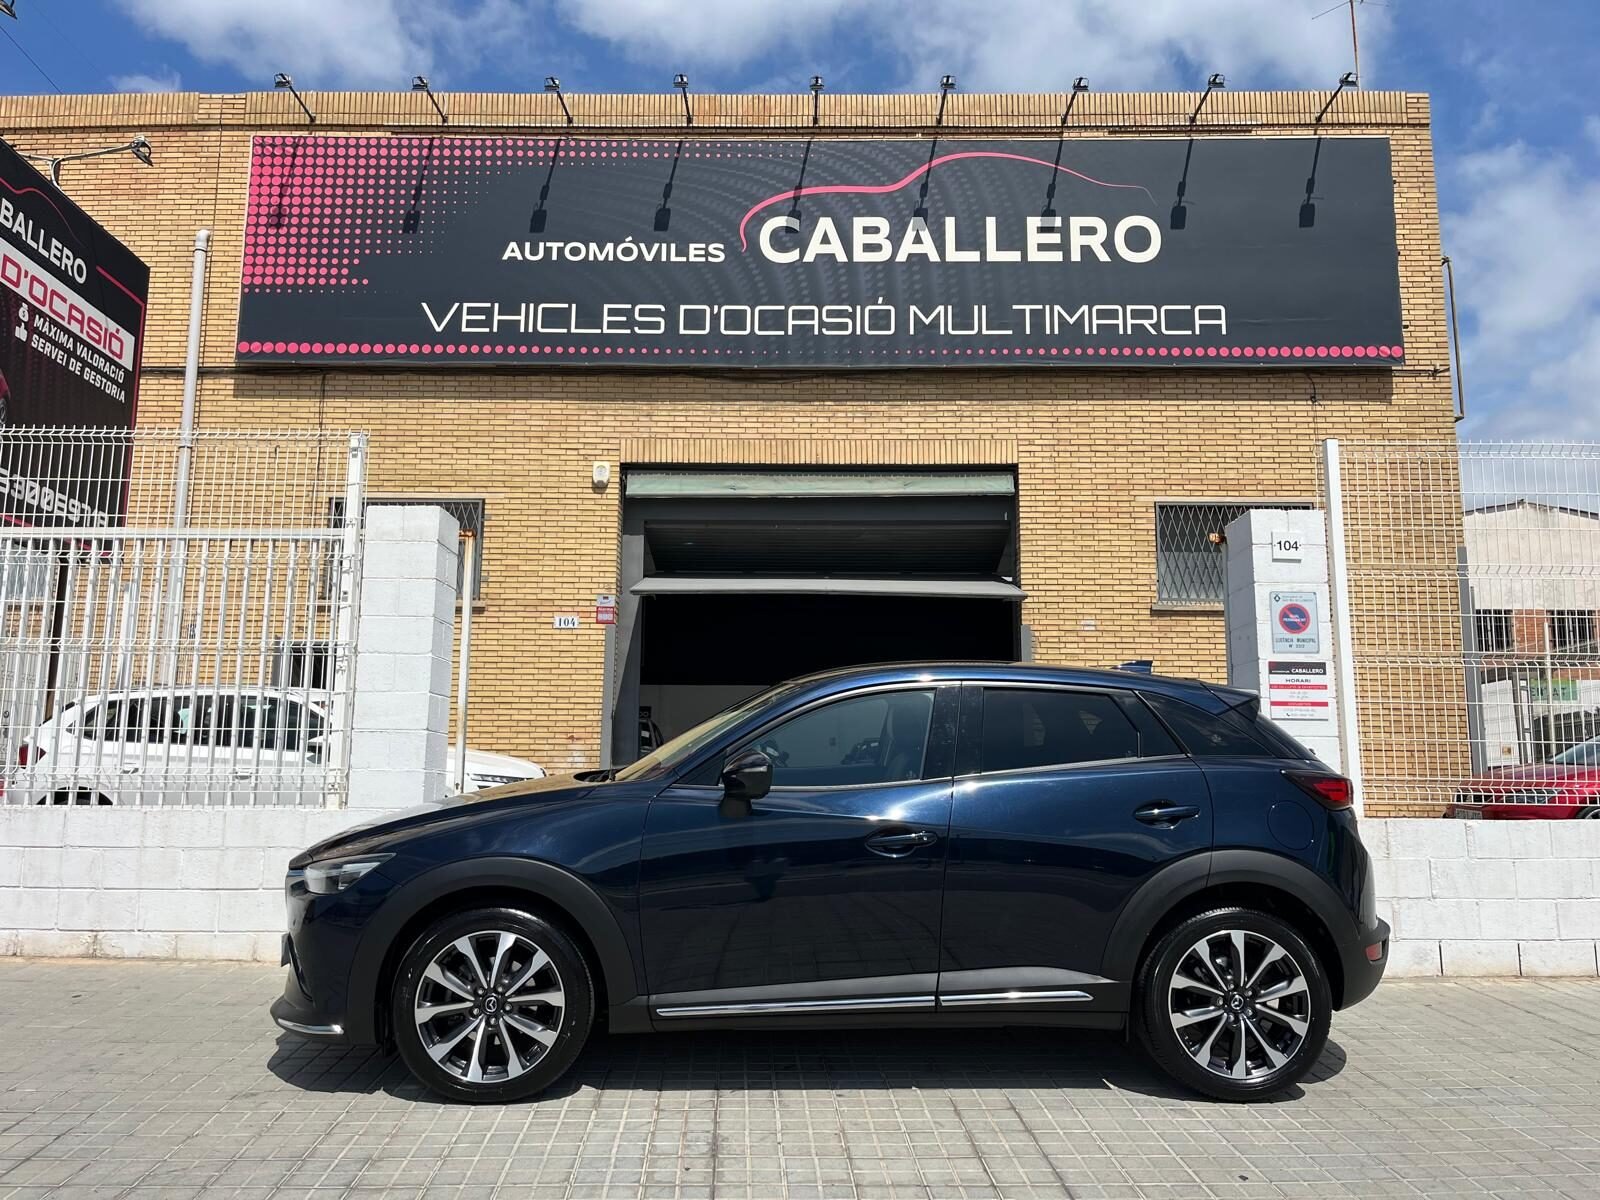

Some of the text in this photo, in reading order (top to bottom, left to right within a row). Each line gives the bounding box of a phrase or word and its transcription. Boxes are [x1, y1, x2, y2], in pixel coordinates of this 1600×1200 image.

[502, 215, 1162, 264] AUTOMÓVILES CABALLERO
[1, 253, 125, 360] D'OCASIÓ
[421, 296, 1227, 336] VEHICLES D'OCASIÓ MULTIMARCA
[31, 334, 125, 404] SERVEI DE GESTORIA
[34, 314, 125, 384] MÀXIMA VALORACIÓ
[1276, 540, 1299, 551] 104
[558, 617, 576, 627] 104
